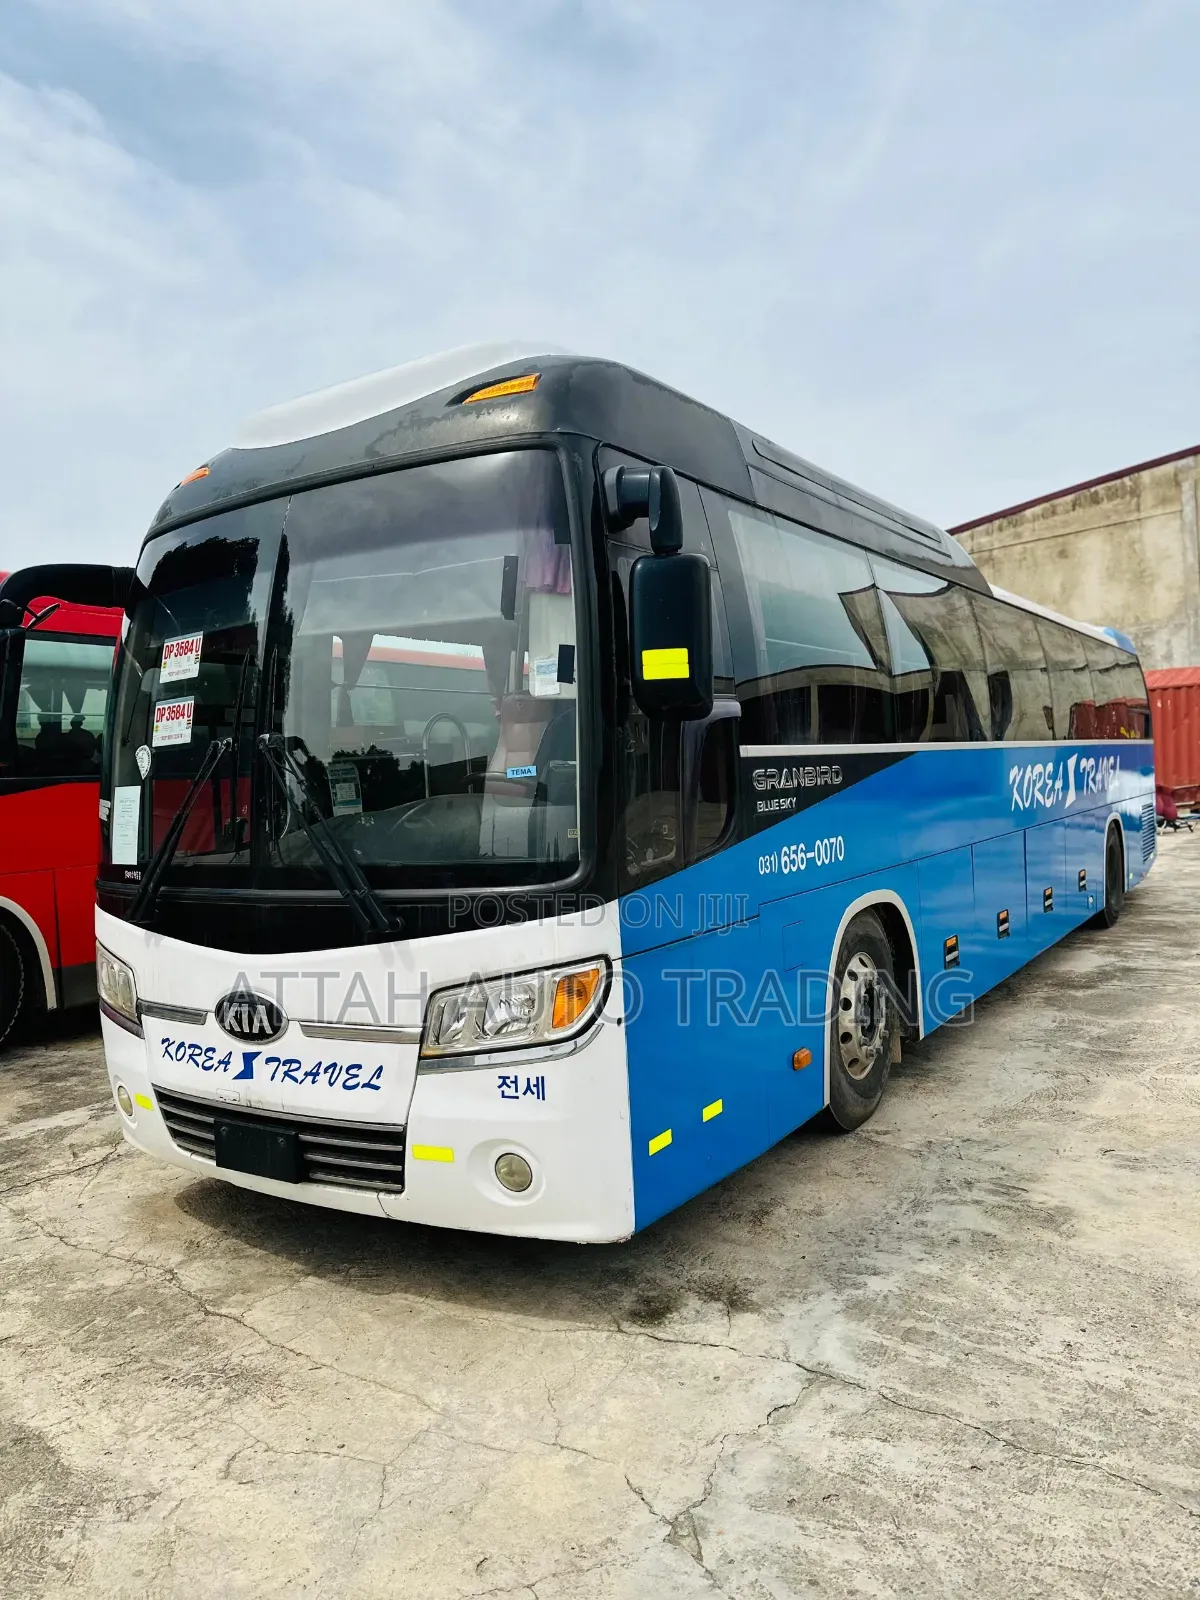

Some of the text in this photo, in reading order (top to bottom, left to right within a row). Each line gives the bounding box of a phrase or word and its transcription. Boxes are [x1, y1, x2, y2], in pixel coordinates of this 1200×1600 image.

[163, 637, 202, 660] DP 3584 U
[155, 702, 193, 724] DP 3584 U
[510, 768, 532, 776] TEMA
[752, 765, 843, 791] GRANBIRD
[1008, 762, 1064, 812] KOREA
[758, 835, 845, 875] 031) 656-0070
[160, 1036, 385, 1091] KOREA TRAVEL
[496, 1074, 546, 1101] 전세
